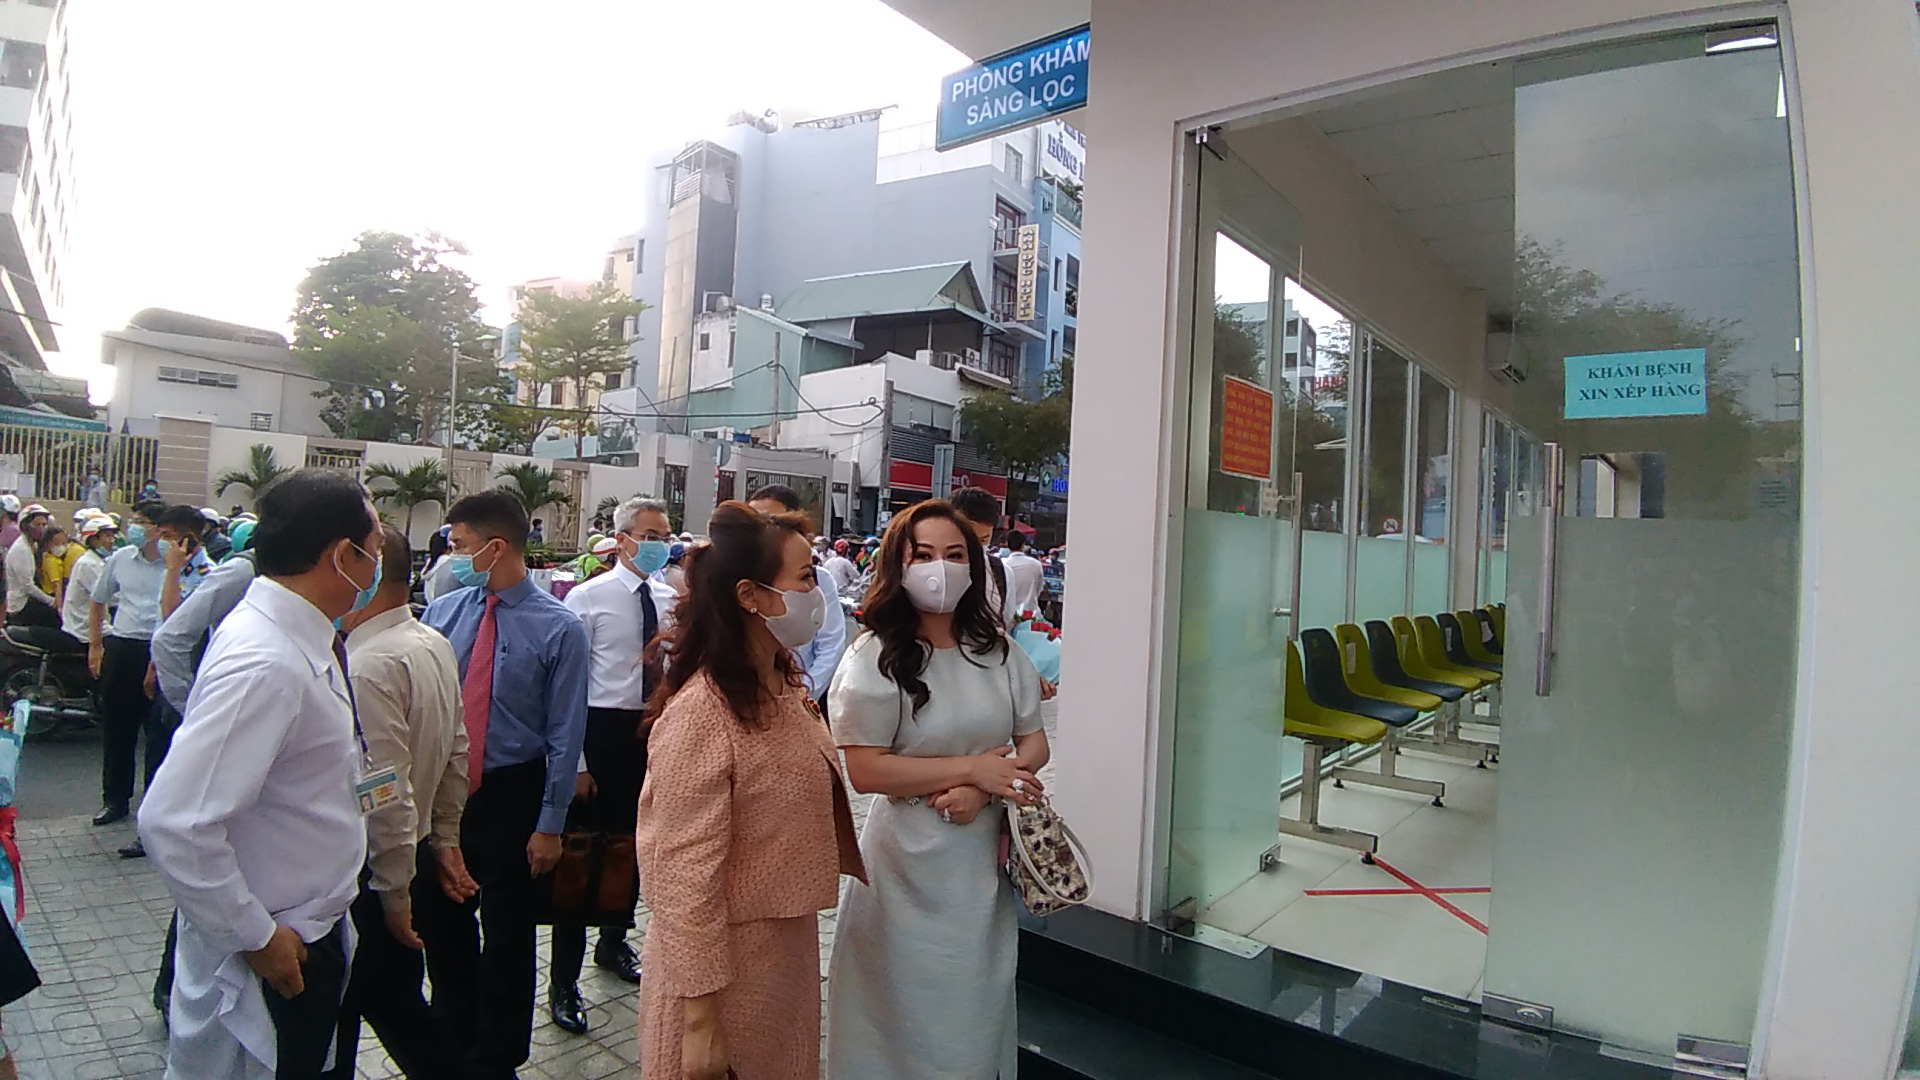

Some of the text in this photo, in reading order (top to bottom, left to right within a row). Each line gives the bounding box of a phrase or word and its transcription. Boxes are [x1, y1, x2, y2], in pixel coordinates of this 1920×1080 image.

[952, 38, 1090, 102] PHÒNG KHÁM
[966, 75, 1075, 125] SÀNG LỌC
[1020, 279, 1032, 317] HOTEL
[1588, 361, 1692, 379] KHÁM BỆNH
[1579, 388, 1608, 401] XIN
[1652, 381, 1701, 398] HÀNG
